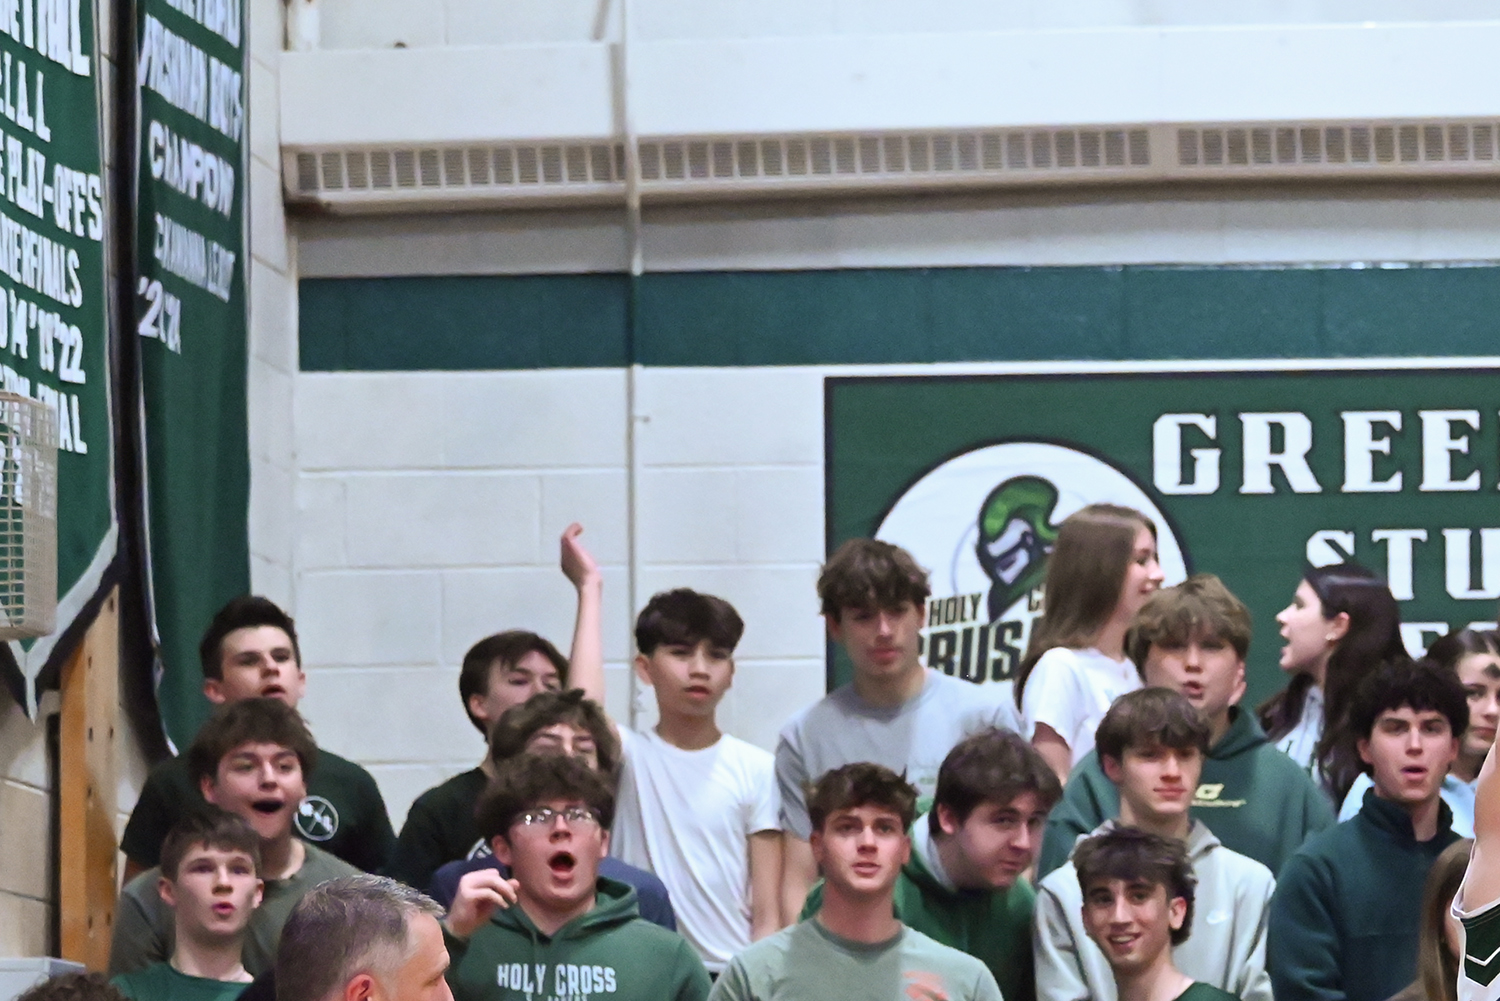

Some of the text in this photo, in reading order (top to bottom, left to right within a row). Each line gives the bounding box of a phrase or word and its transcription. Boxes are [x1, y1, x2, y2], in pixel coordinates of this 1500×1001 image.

[928, 592, 982, 627] HOLY
[497, 962, 617, 997] HOLY CROSS
